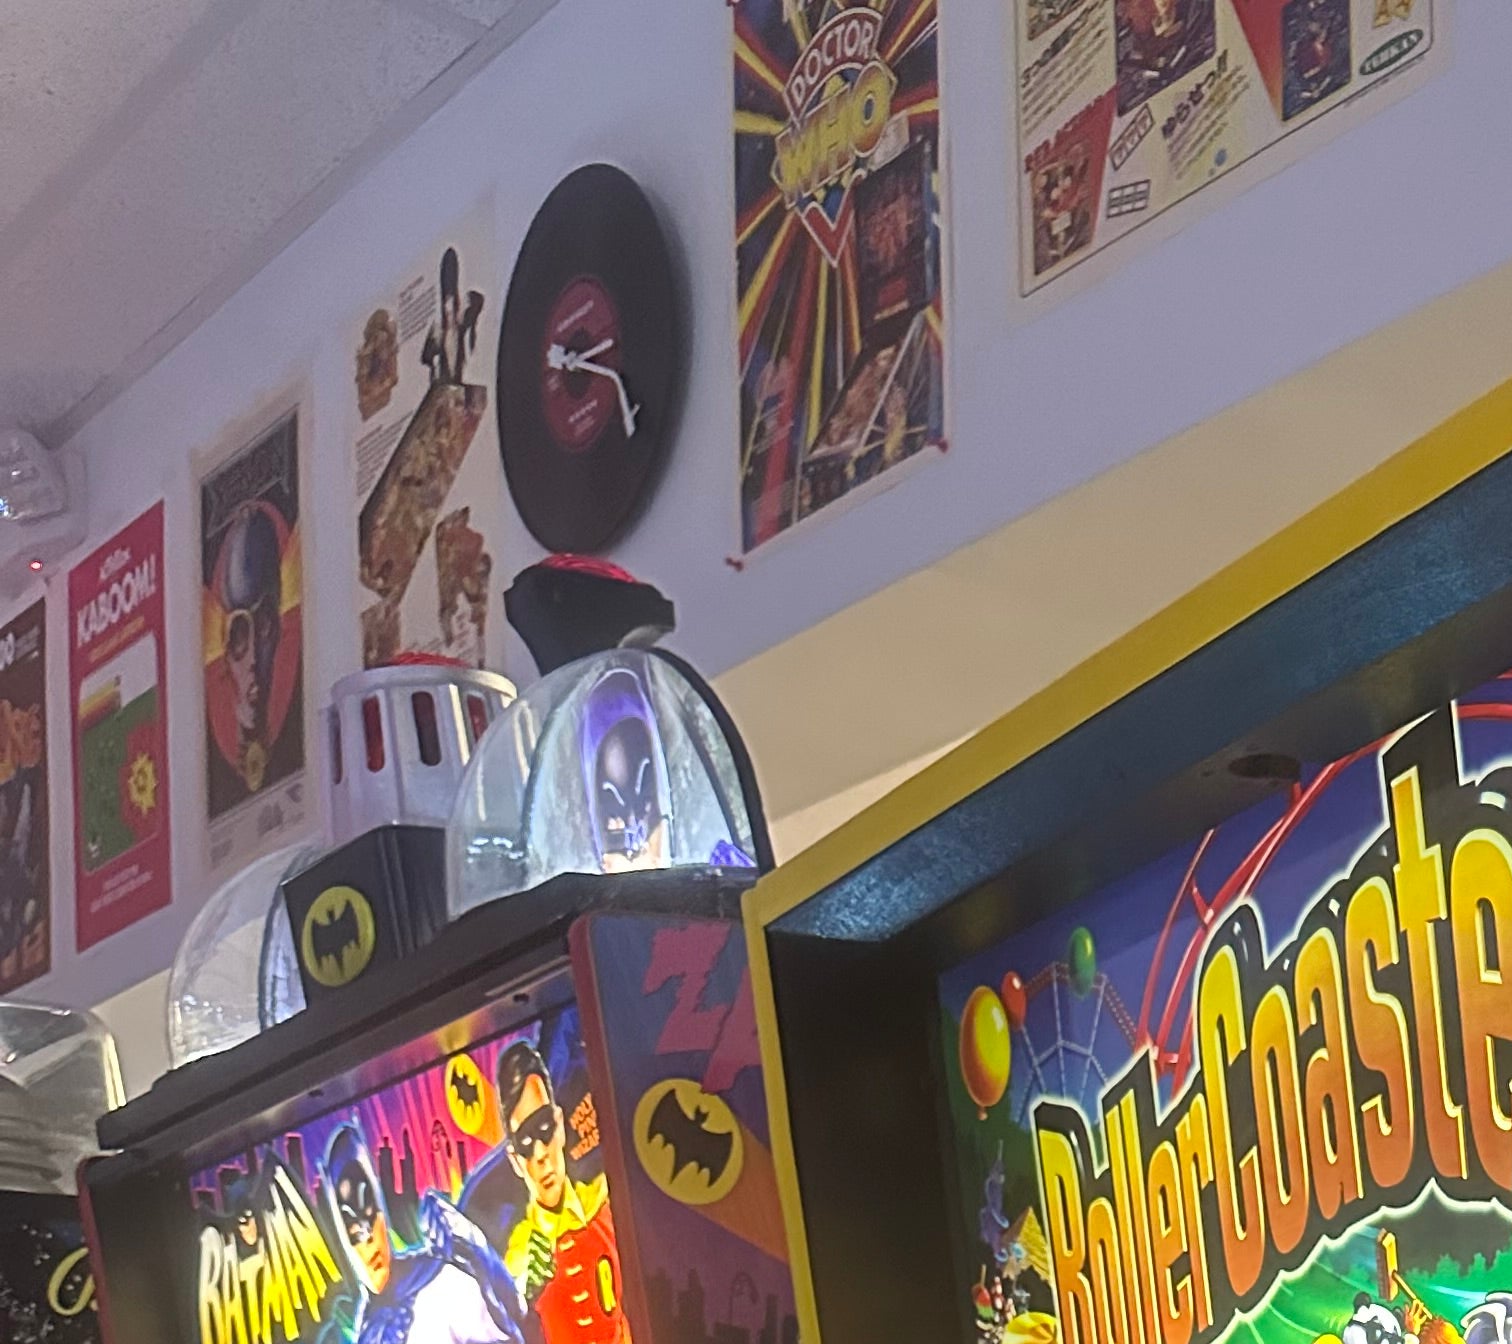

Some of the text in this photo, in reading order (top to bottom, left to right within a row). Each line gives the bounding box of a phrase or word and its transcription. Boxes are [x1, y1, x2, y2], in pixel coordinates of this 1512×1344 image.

[790, 20, 876, 107] DOCTOR
[771, 60, 897, 208] WHO
[76, 553, 157, 649] KABOOM!
